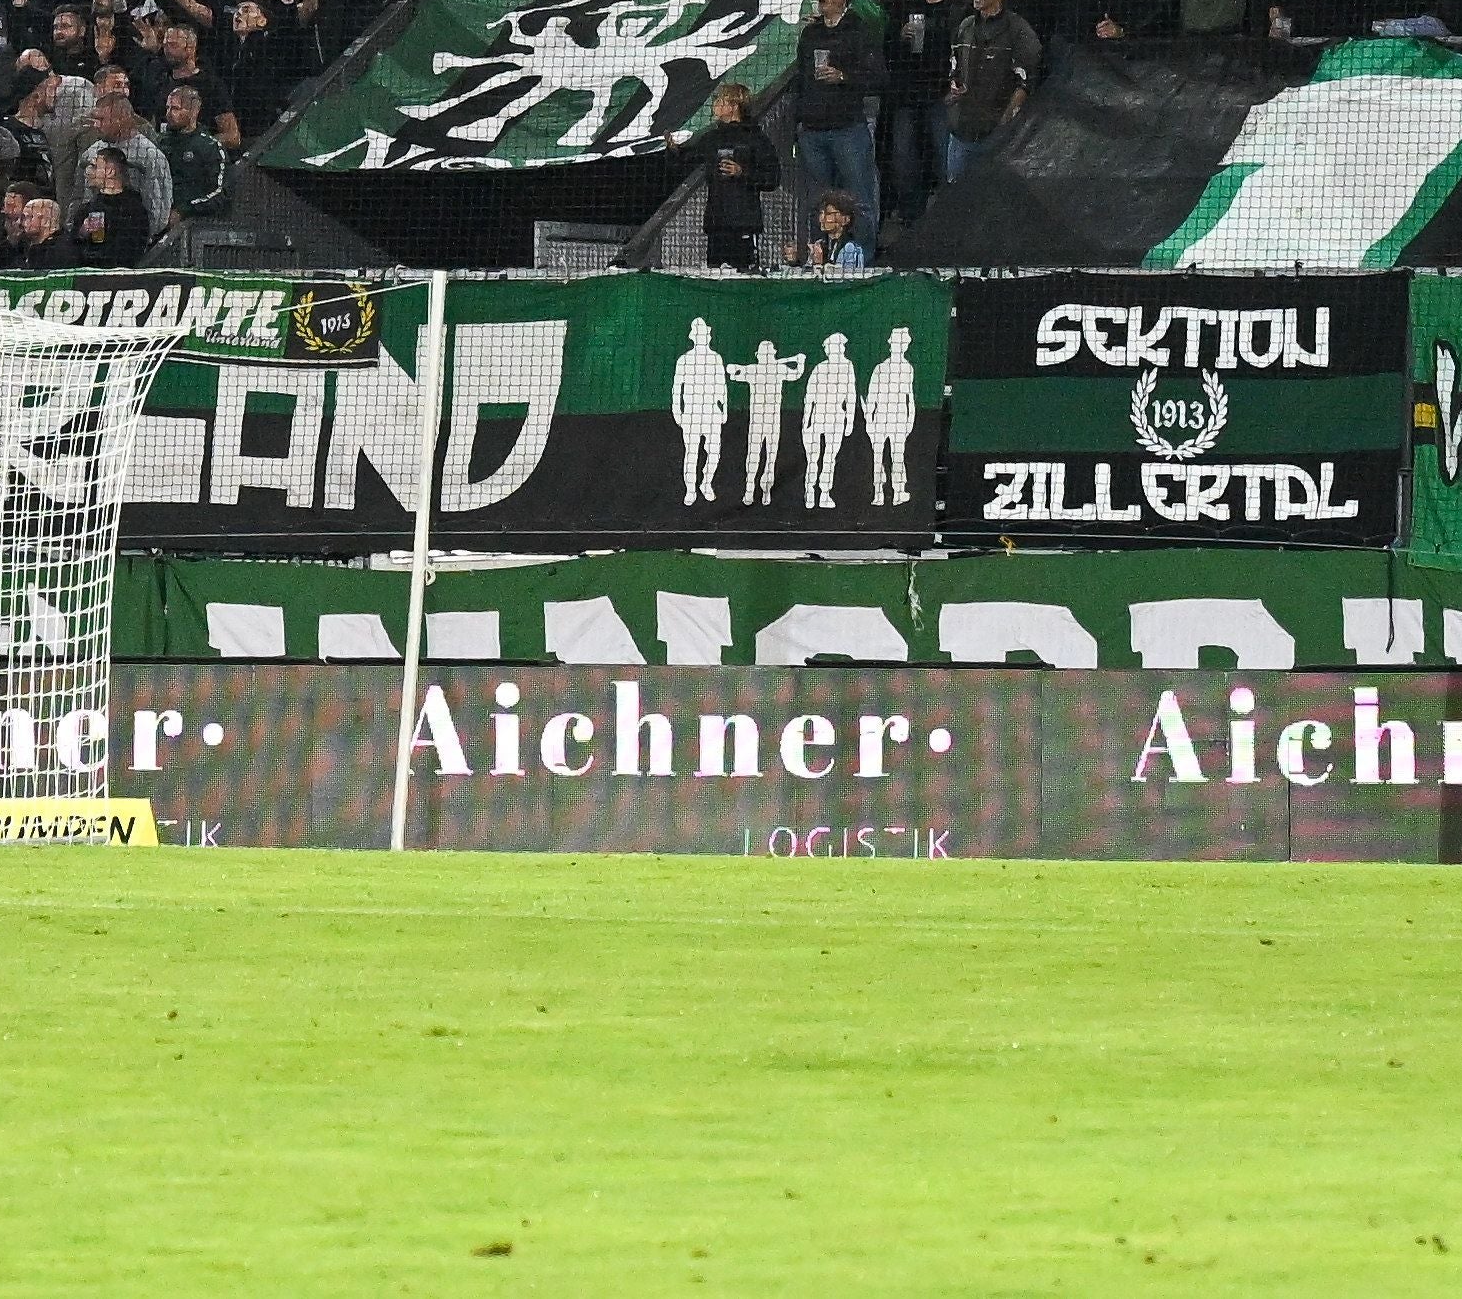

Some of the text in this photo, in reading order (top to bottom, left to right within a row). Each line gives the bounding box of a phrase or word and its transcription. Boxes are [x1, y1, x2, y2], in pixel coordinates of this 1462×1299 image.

[1035, 304, 1330, 370] SEKTION
[1151, 399, 1206, 433] 1913
[983, 461, 1360, 522] ZILLERTAL
